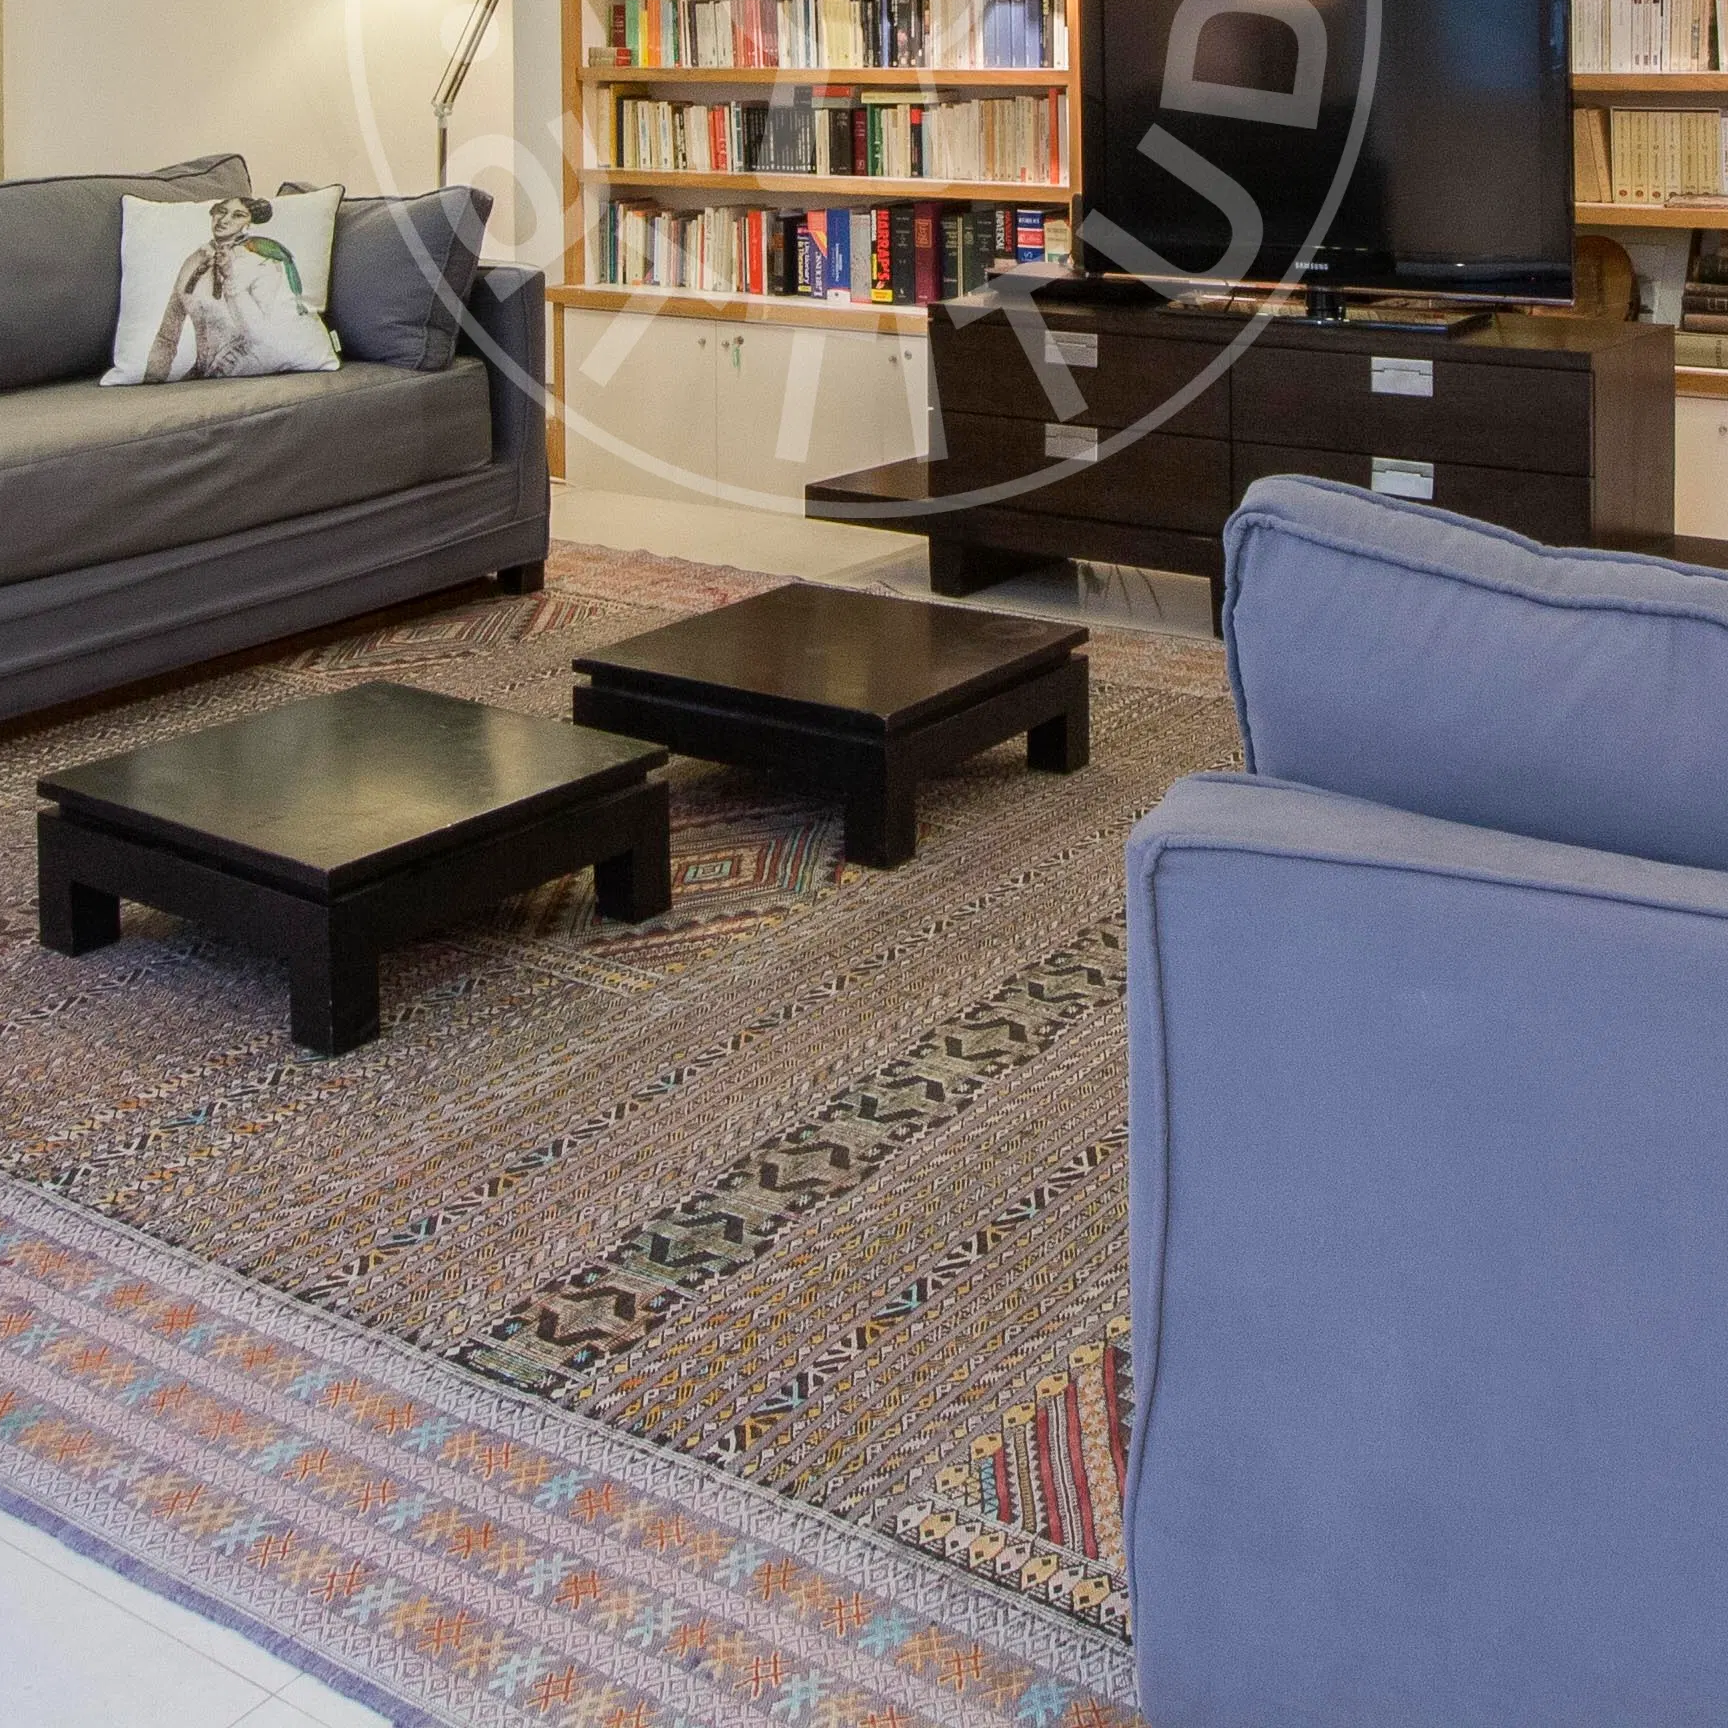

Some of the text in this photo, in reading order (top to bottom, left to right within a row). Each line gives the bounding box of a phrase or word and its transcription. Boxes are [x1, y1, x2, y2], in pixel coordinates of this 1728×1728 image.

[877, 210, 890, 281] HARRAP'S
[995, 210, 1005, 251] UNIVERSAL
[1294, 261, 1329, 271] SAMSUNG
